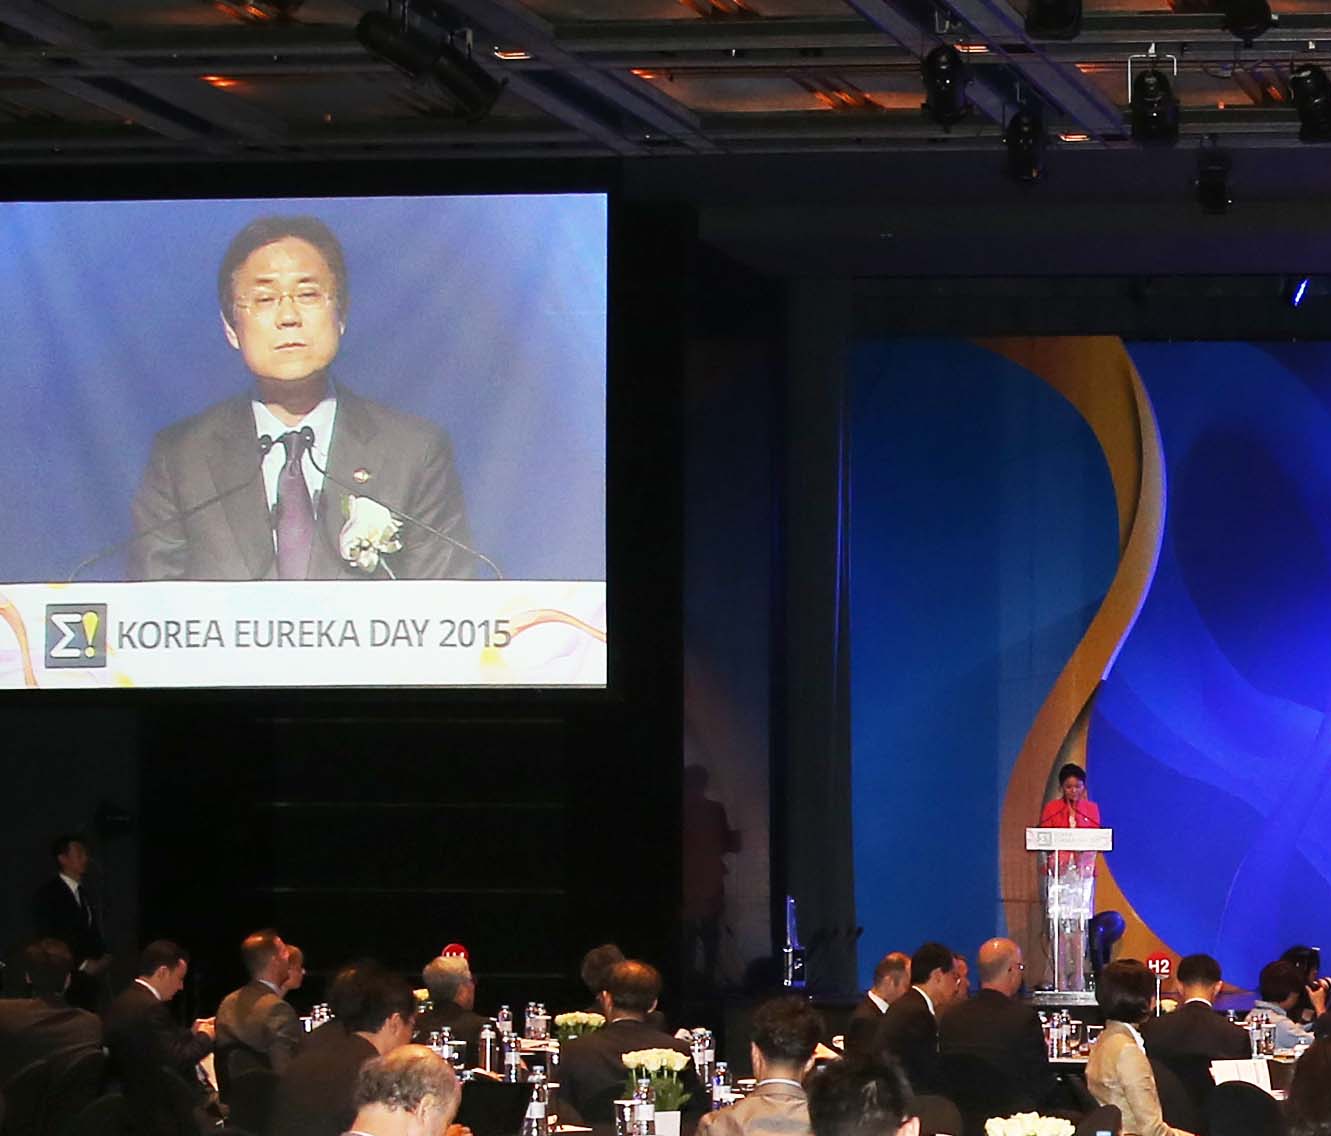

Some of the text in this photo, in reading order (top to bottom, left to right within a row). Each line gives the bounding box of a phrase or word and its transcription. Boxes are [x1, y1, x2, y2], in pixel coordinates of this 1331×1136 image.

[117, 618, 512, 649] KOREA EUREKA DAY 2015
[1148, 959, 1170, 974] H2
